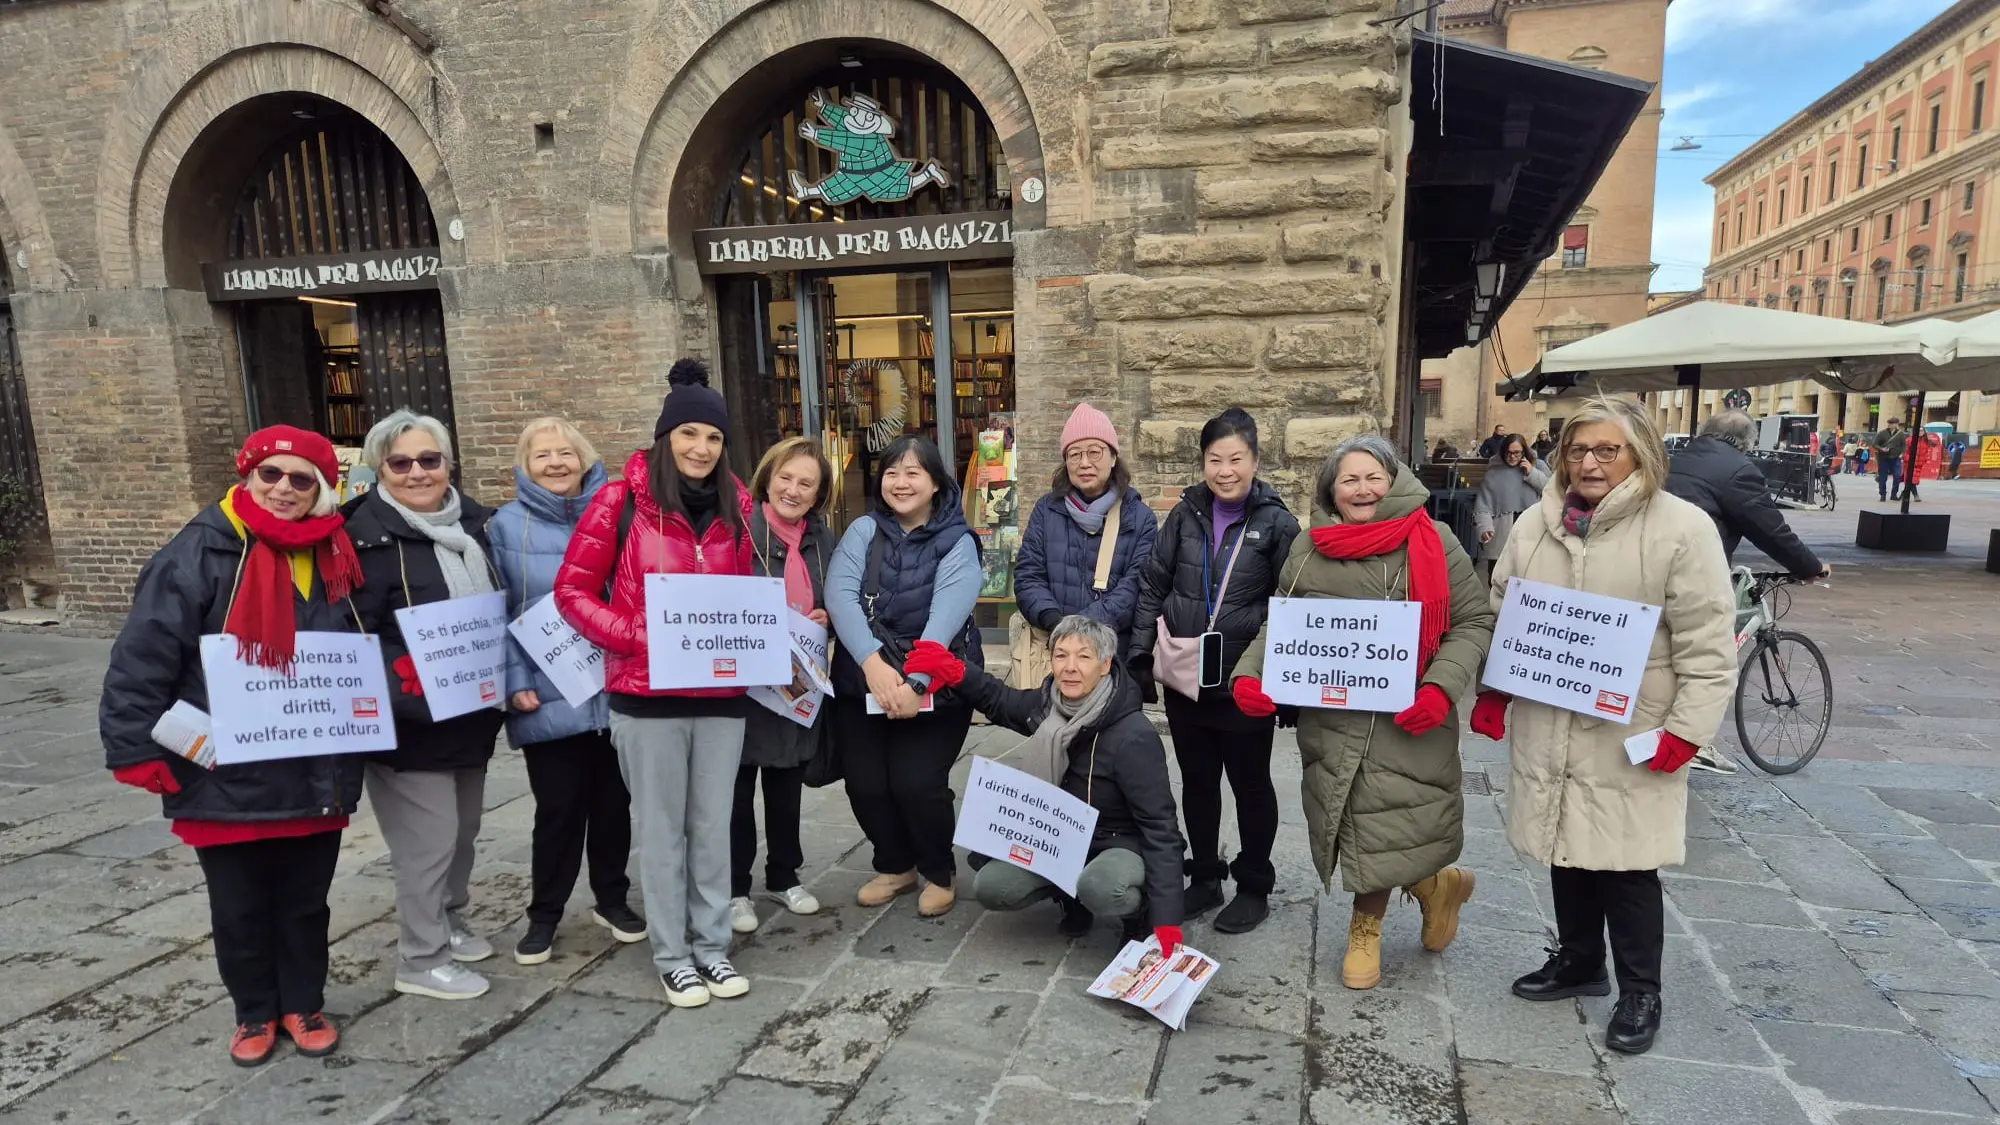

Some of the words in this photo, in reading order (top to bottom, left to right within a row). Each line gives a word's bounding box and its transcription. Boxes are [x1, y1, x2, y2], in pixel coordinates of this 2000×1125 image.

[709, 236, 834, 262] LIBRERIA
[837, 229, 890, 255] PER
[897, 219, 1012, 251] RAGAZZI
[223, 266, 318, 290] LIBRERIA
[317, 262, 360, 285] PER
[363, 255, 439, 282] RAGAZZ
[663, 610, 682, 624] La
[688, 611, 737, 624] nostra
[742, 609, 777, 625] forza
[1520, 593, 1547, 611] Non
[1550, 601, 1564, 615] ci
[1566, 605, 1612, 625] serve
[1616, 613, 1628, 628] il
[417, 629, 437, 641] Se
[438, 623, 448, 636] ti
[451, 617, 492, 638] picchia,
[1306, 613, 1325, 629] Le
[1330, 614, 1378, 631] mani
[681, 634, 691, 650] è
[696, 635, 765, 650] collettiva
[800, 635, 815, 650] SPI
[1526, 621, 1596, 647] principe:
[294, 650, 342, 664] olenza
[346, 650, 357, 664] si
[424, 645, 470, 662] amore.
[544, 632, 581, 665] posse
[1274, 639, 1360, 659] addosso?
[1365, 643, 1409, 661] Solo
[1503, 637, 1513, 650] ci
[1514, 638, 1551, 660] basta
[1556, 651, 1585, 669] che
[1589, 660, 1623, 678] non
[573, 659, 585, 672] il
[245, 673, 332, 692] combatte
[337, 676, 363, 688] con
[435, 676, 449, 689] lo
[453, 671, 477, 684] dice
[478, 668, 493, 679] sua
[1282, 670, 1302, 683] se
[1308, 668, 1389, 689] balliamo
[1509, 663, 1528, 678] sia
[1532, 670, 1551, 684] un
[1556, 677, 1592, 695] orco
[283, 698, 336, 716] diritti,
[234, 726, 308, 744] welfare
[313, 727, 323, 738] e
[329, 722, 380, 737] cultura
[978, 777, 982, 787] I
[985, 779, 1018, 799] diritti
[1021, 793, 1050, 812] delle
[1052, 807, 1086, 833] donne
[998, 804, 1024, 822] non
[1028, 816, 1060, 837] sono
[988, 822, 1060, 859] negoziabili
